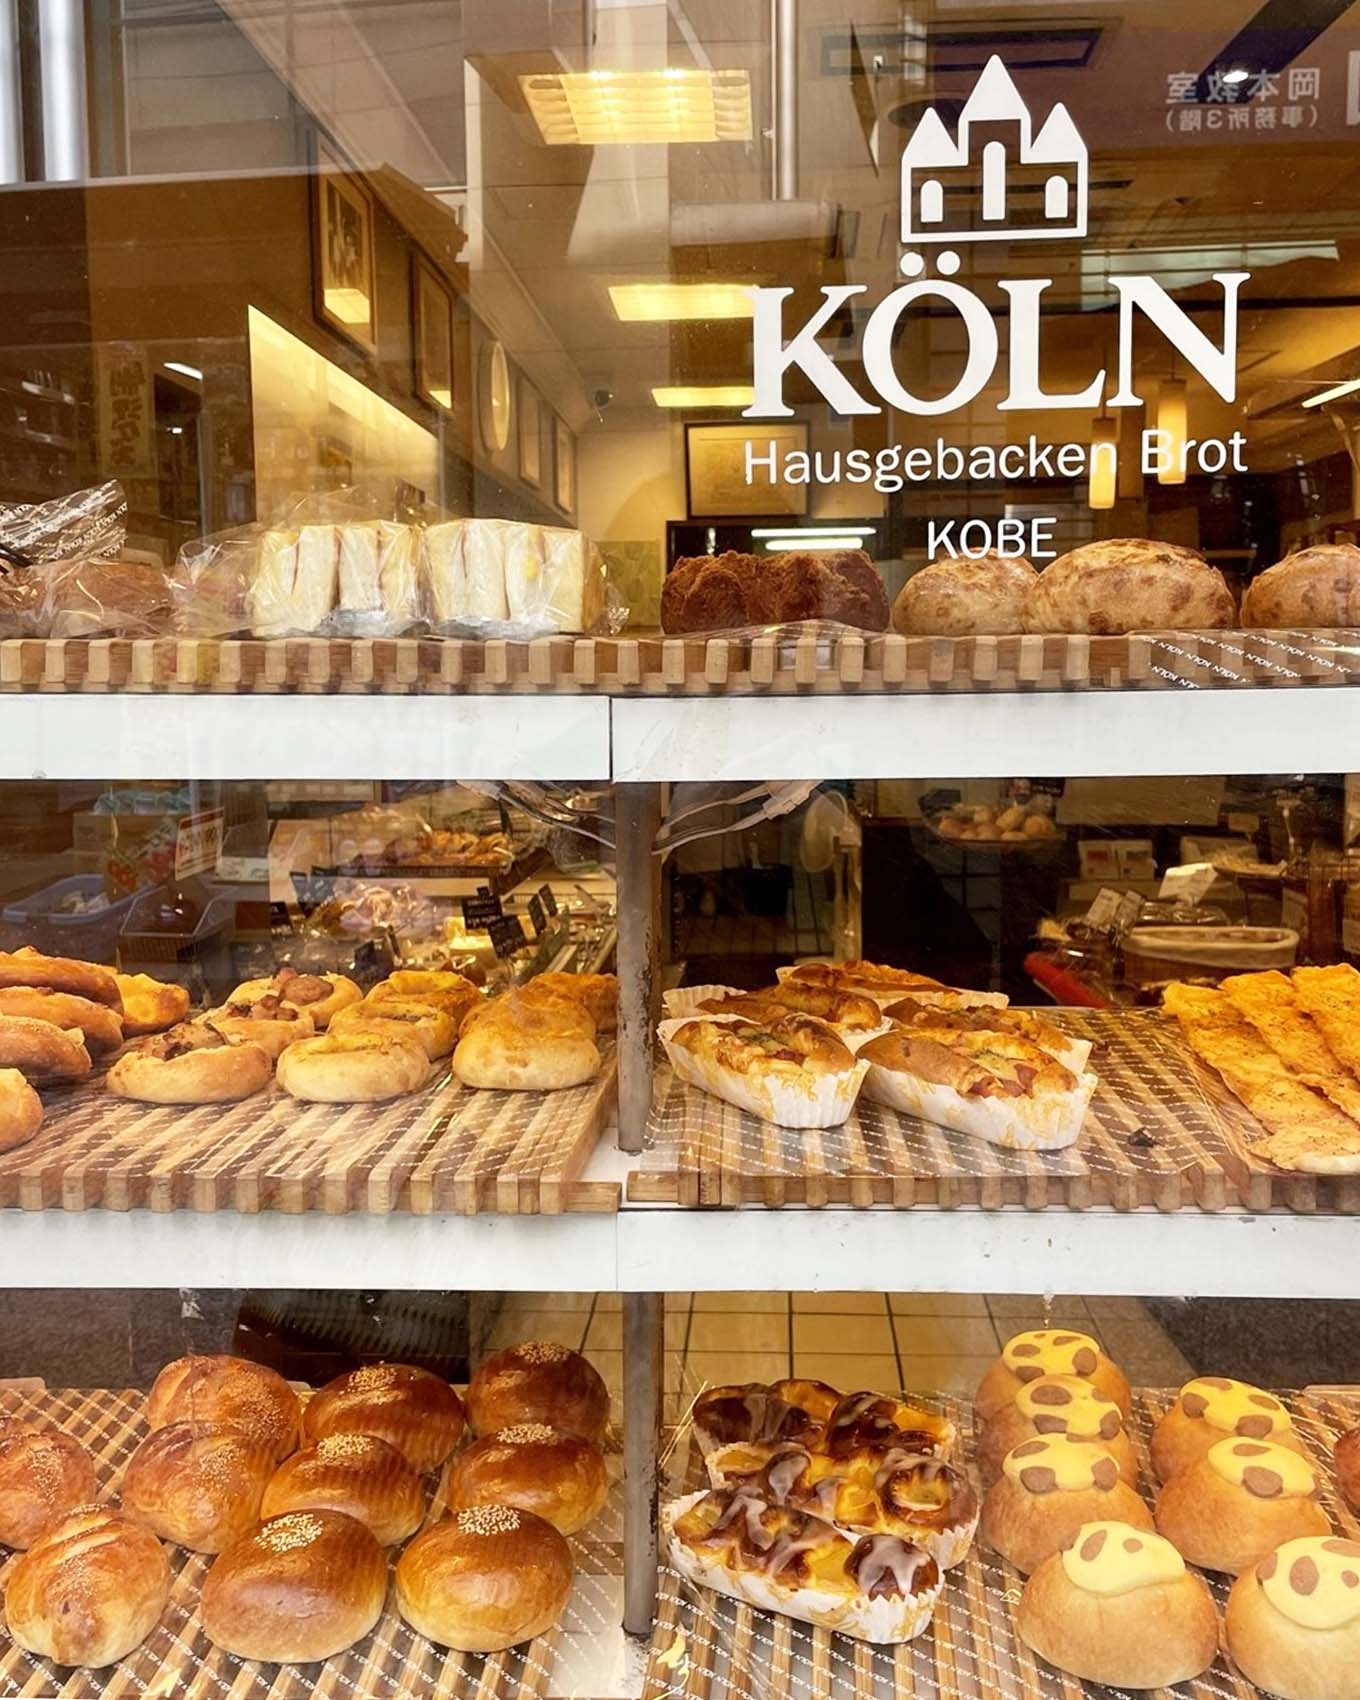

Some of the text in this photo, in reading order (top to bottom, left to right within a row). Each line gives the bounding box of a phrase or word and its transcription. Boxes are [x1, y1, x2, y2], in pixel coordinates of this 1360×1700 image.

[742, 251, 1250, 416] KÖLN
[743, 429, 1248, 493] Hausgebacken Brot
[927, 517, 1057, 560] KOBE
